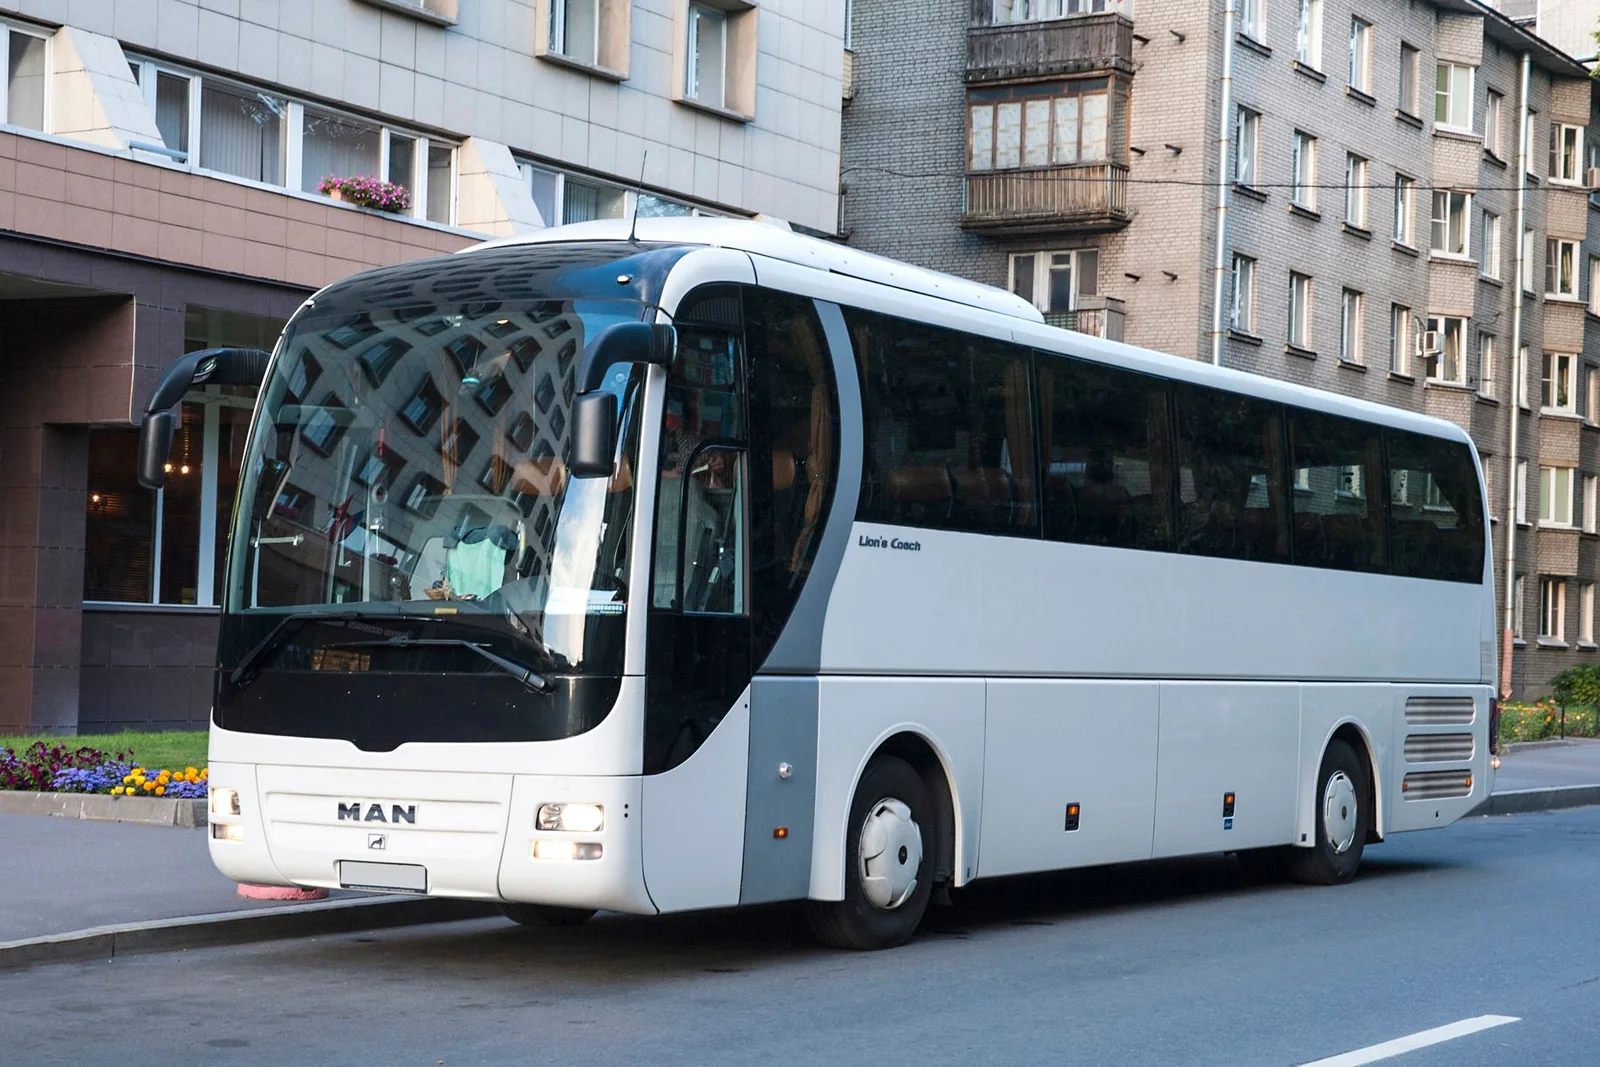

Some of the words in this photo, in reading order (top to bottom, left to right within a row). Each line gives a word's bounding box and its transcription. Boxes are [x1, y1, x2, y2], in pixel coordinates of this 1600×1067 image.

[859, 535, 888, 548] Lion's
[890, 538, 921, 551] Coach
[338, 802, 416, 824] MAN
